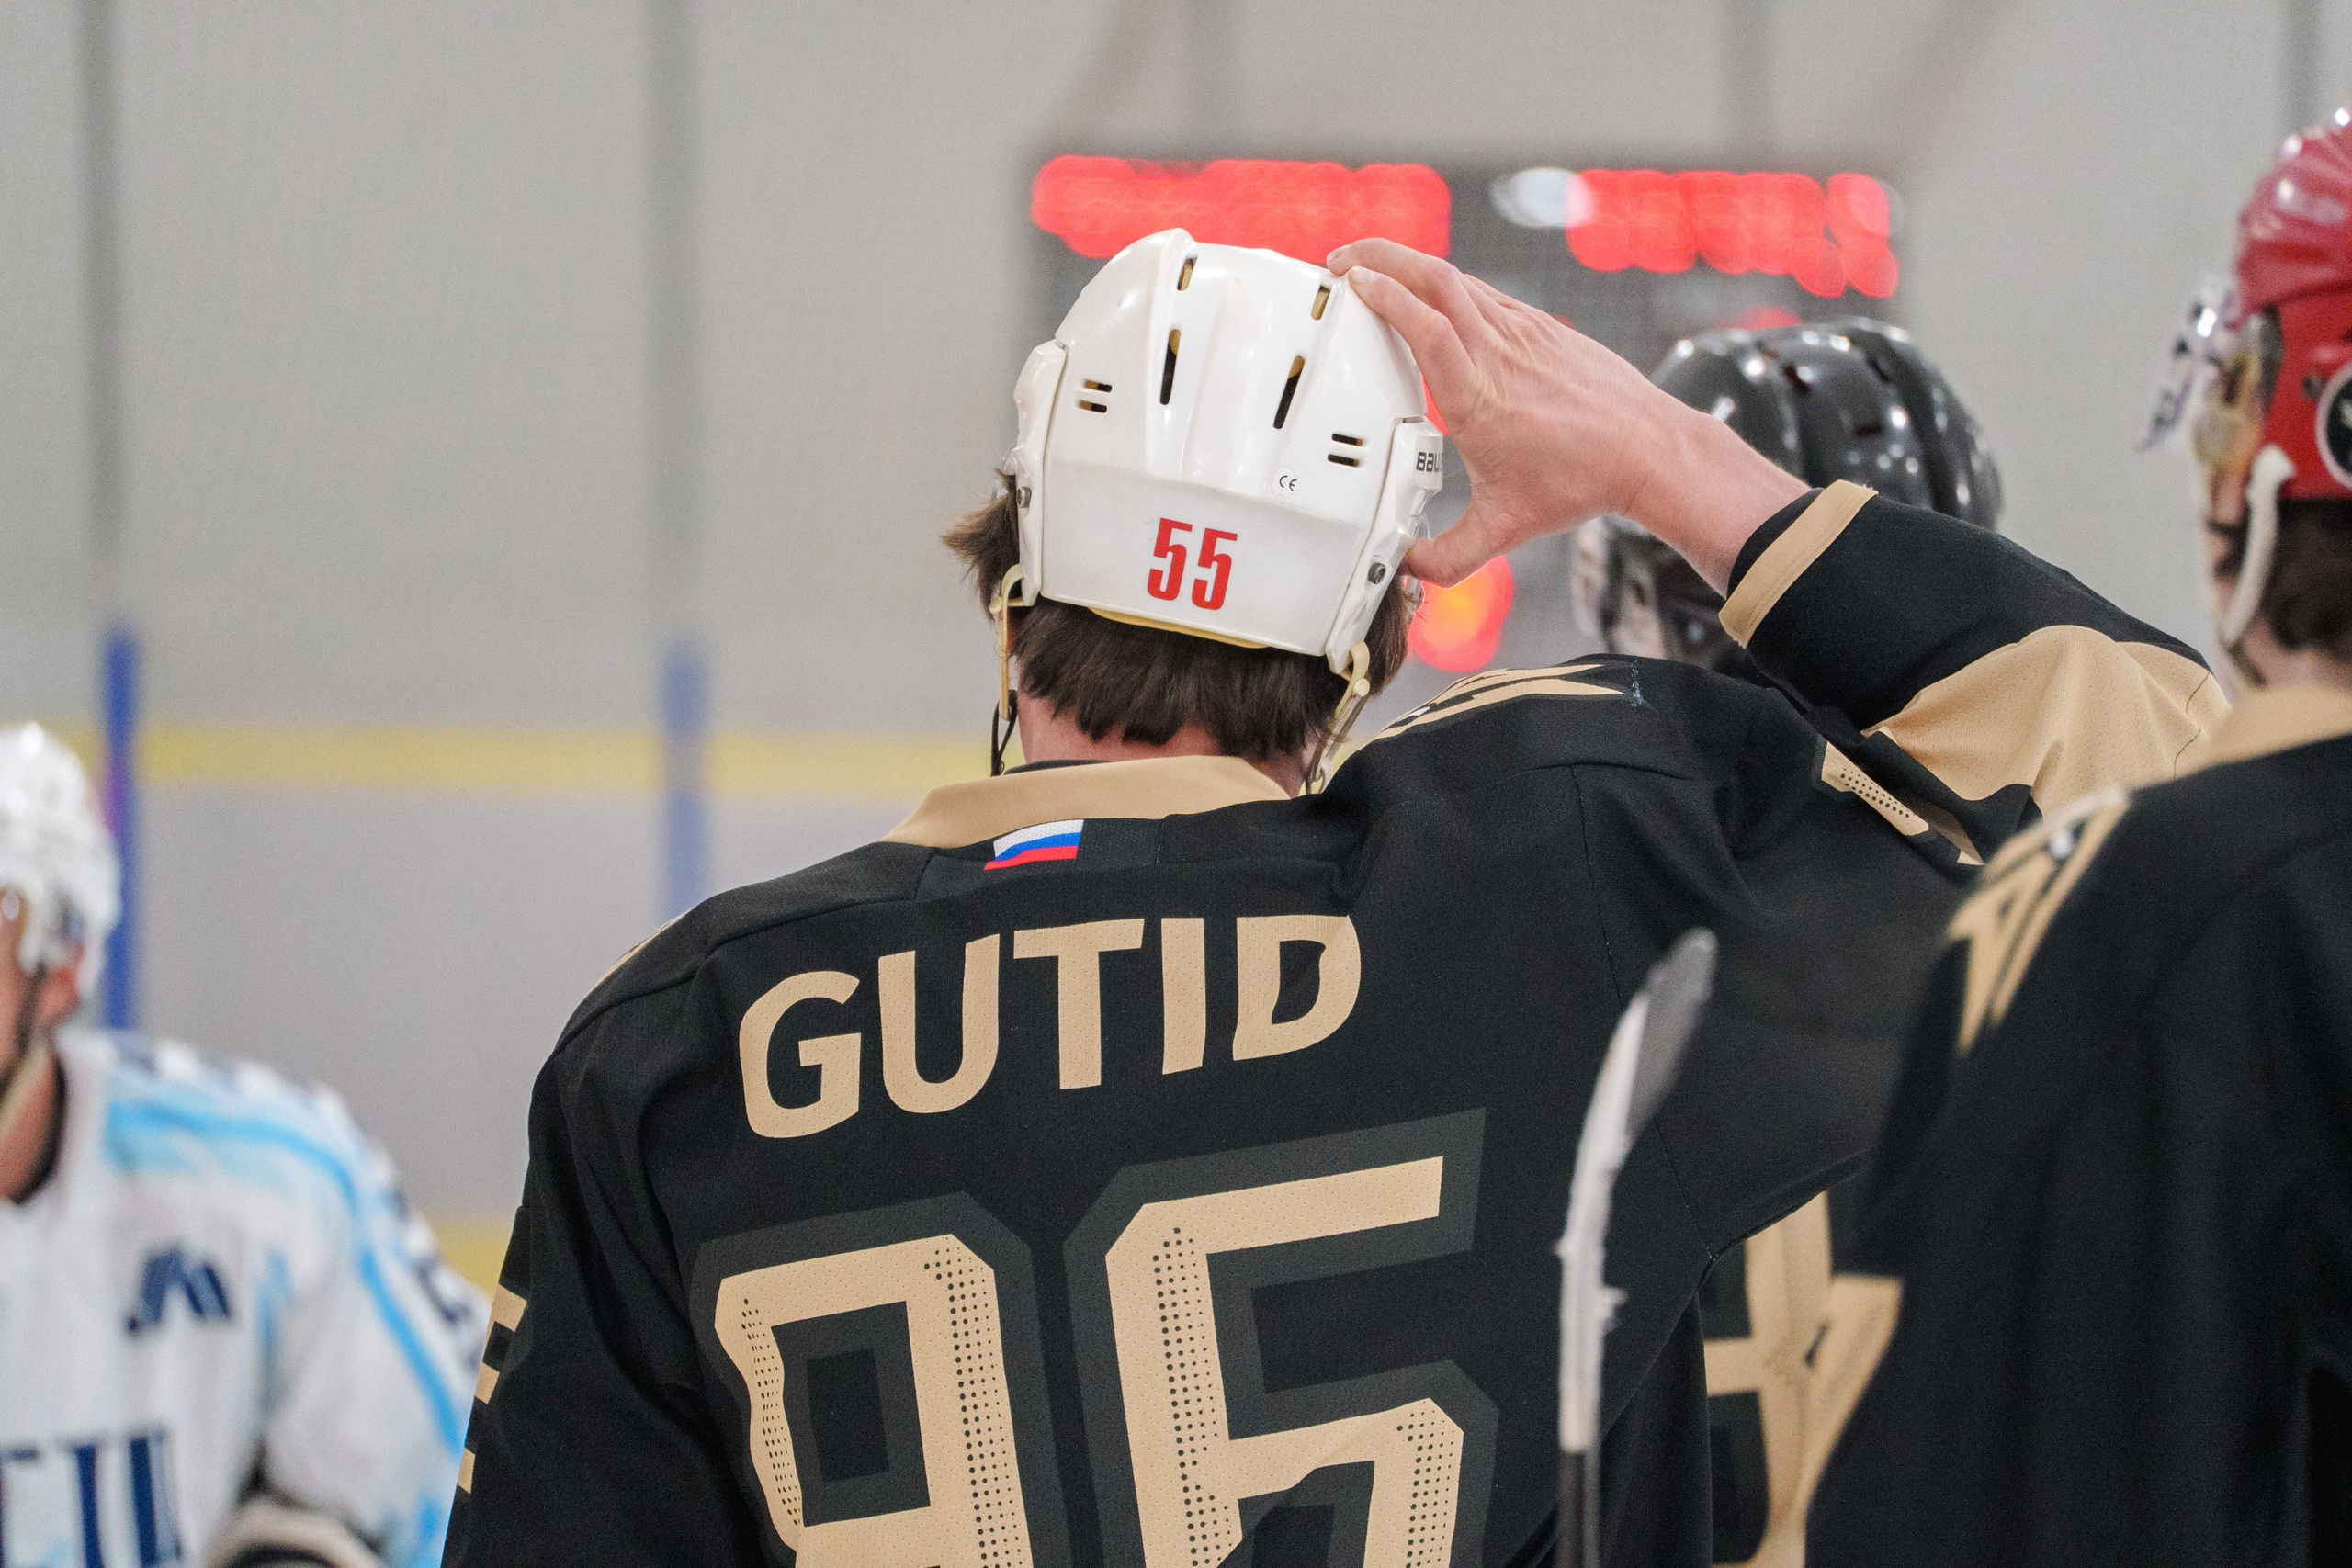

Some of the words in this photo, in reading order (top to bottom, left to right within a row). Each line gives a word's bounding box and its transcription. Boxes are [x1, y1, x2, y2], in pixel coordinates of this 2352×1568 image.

[1279, 475, 1297, 491] CE
[1147, 517, 1238, 611] 55
[739, 914, 1361, 1139] GUTID
